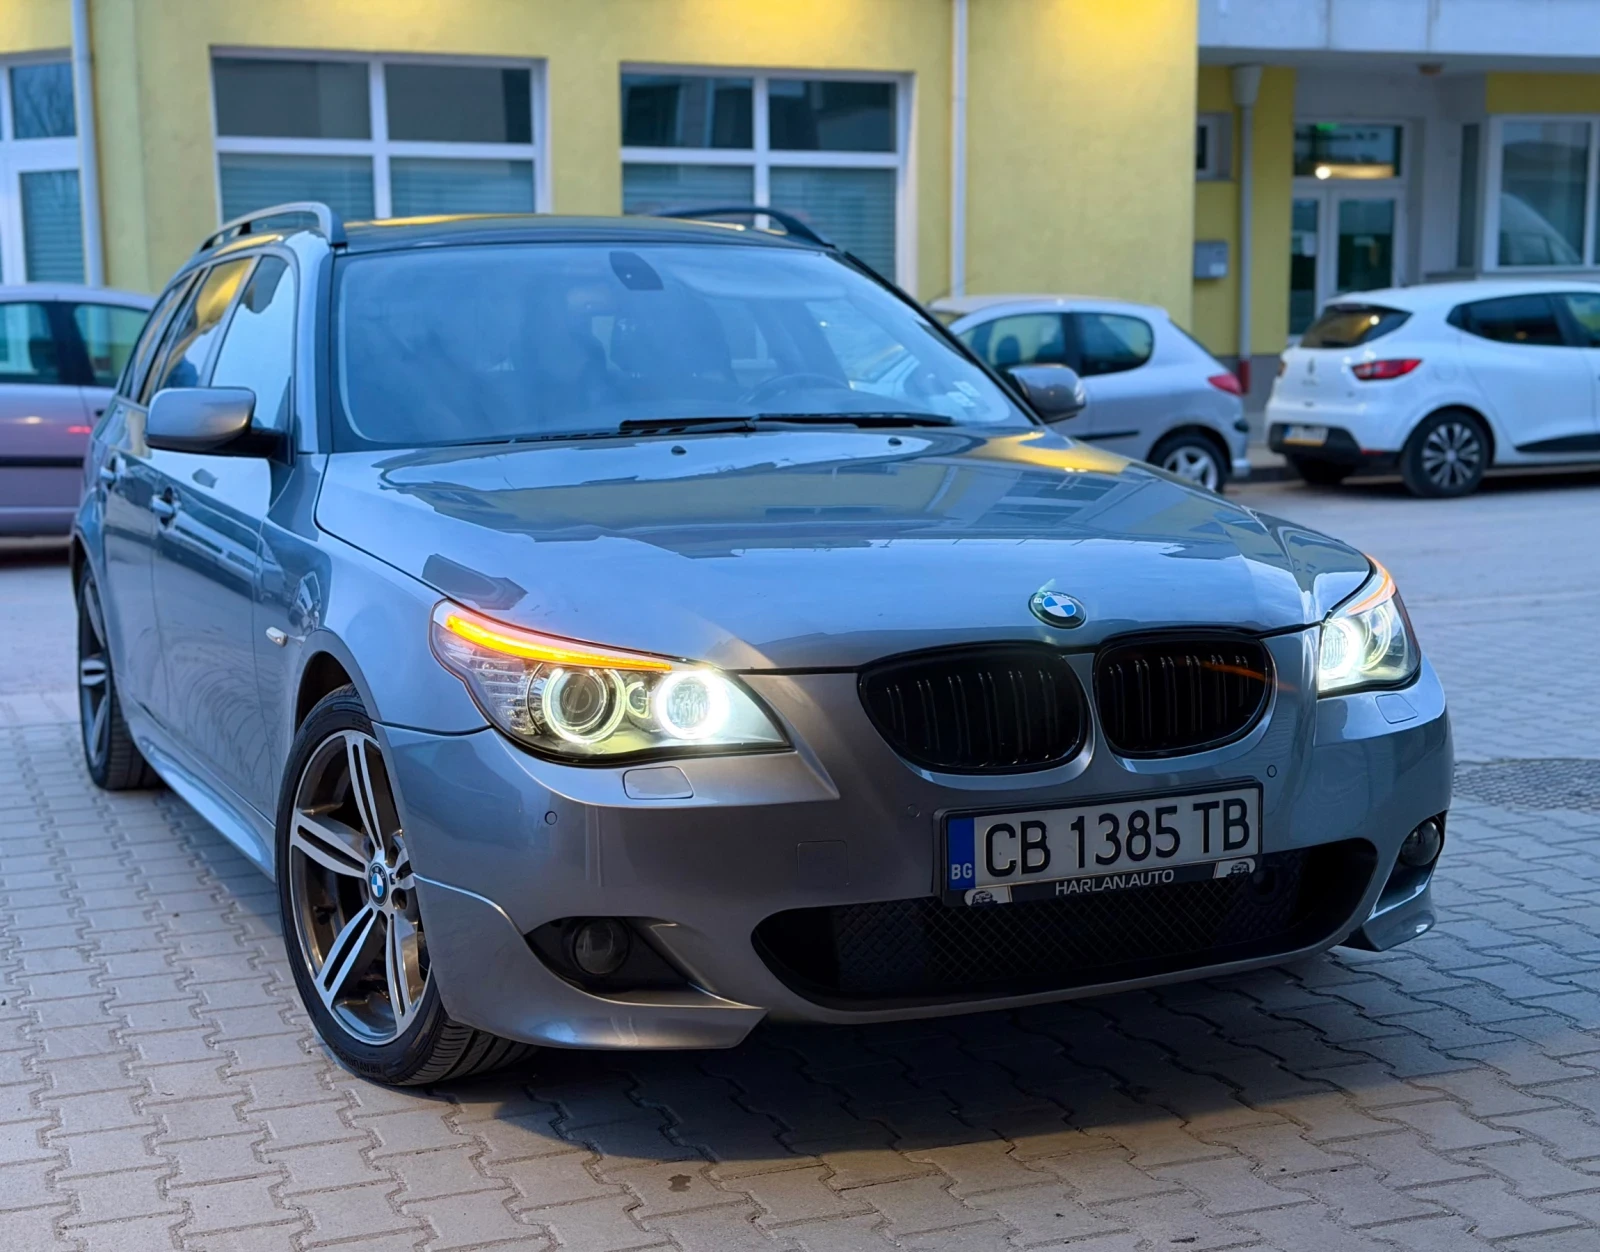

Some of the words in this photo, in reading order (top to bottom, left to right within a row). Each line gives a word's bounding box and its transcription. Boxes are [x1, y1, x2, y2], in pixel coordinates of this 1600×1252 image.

[985, 820, 1051, 878] CB
[1069, 805, 1181, 869] 1385
[1193, 798, 1251, 854] TB
[951, 863, 973, 880] BG
[1055, 869, 1175, 896] HARLAN.AUTO
